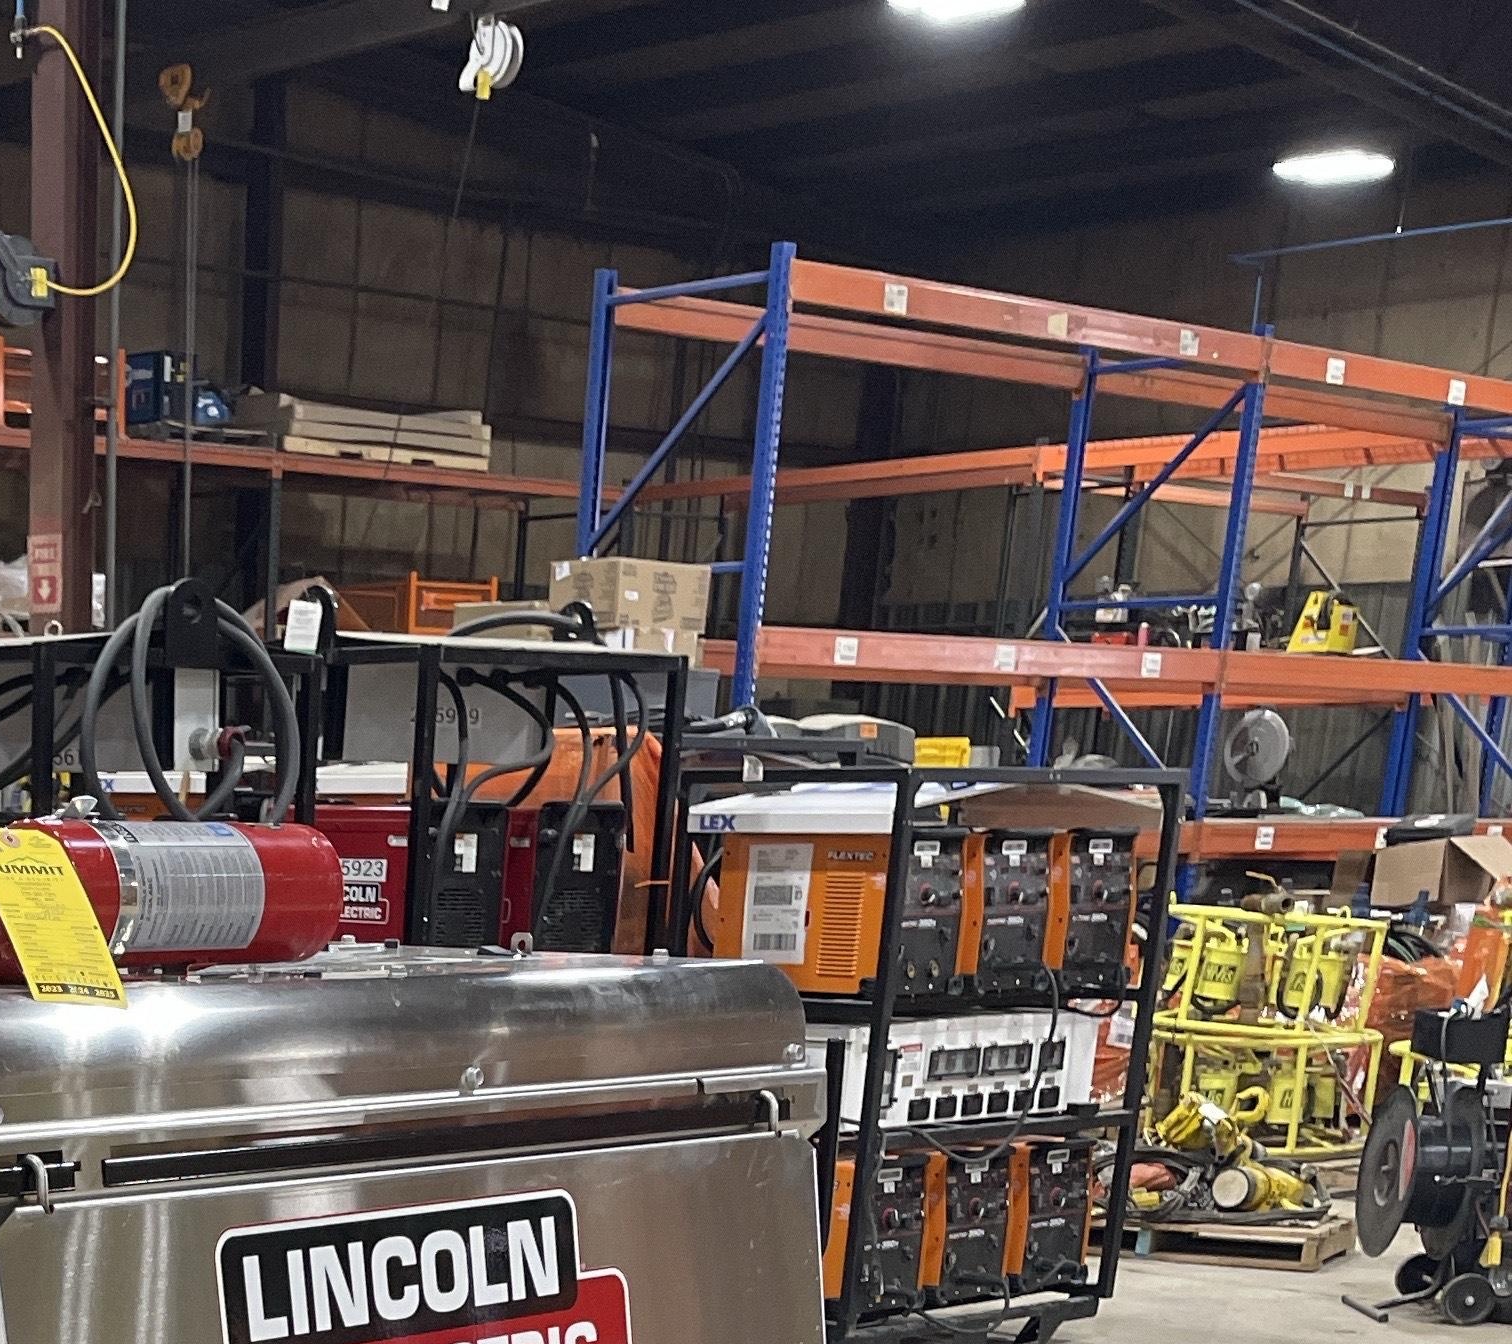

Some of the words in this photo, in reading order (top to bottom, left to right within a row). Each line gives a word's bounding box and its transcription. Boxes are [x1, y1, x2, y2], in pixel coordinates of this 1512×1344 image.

[699, 815, 736, 831] LEX
[341, 860, 384, 877] 5923
[343, 886, 377, 903] COLN
[340, 906, 383, 920] ECTRIC
[242, 1215, 561, 1343] LINCOLN
